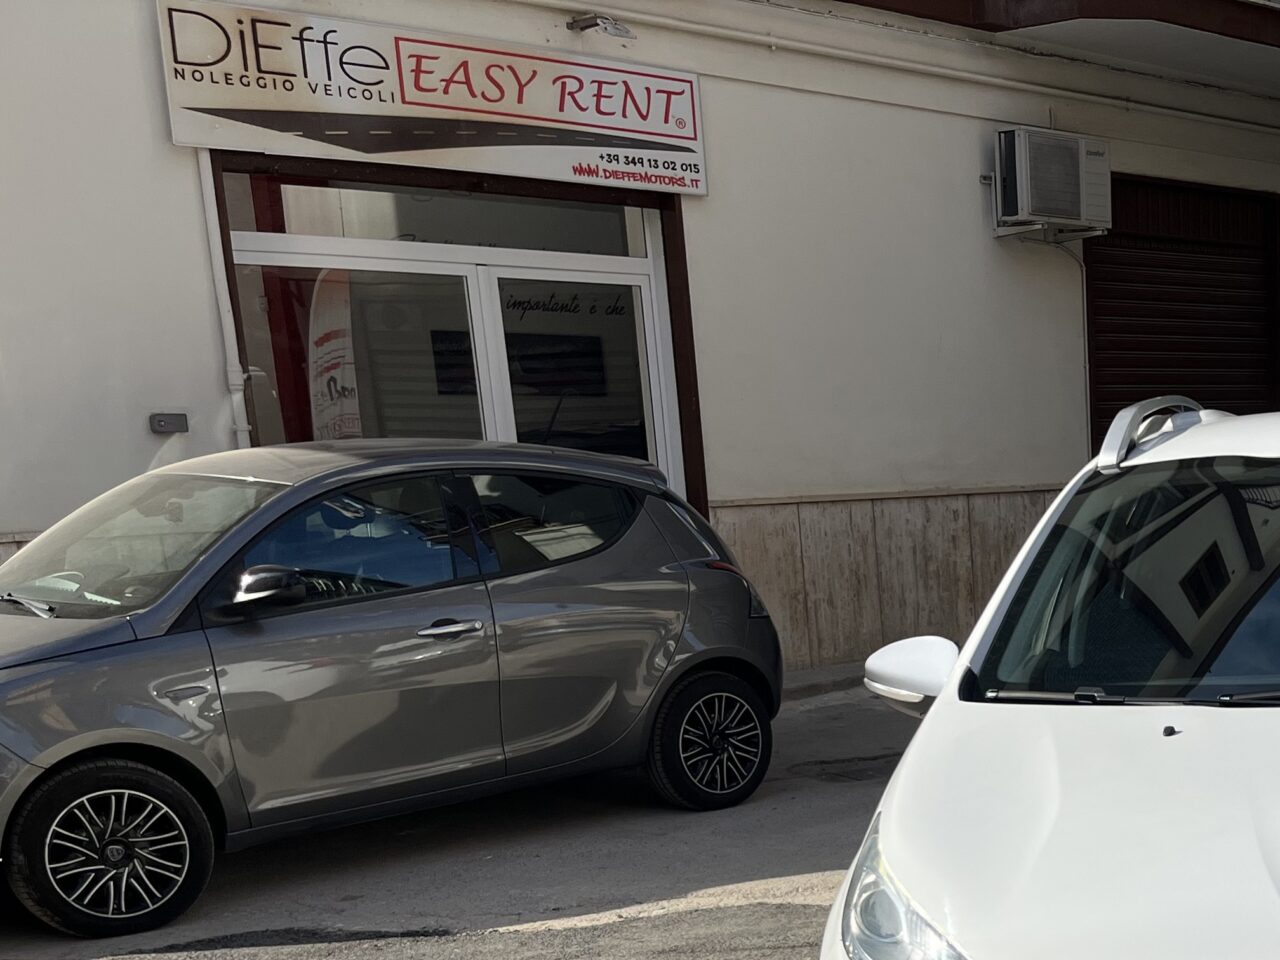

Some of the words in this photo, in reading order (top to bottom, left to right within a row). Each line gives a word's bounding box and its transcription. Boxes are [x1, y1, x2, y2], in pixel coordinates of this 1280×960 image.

[168, 8, 390, 86] DiEffe
[174, 67, 295, 92] NOLEGGIO
[308, 82, 395, 103] VEICOLI
[407, 54, 538, 104] EASY
[552, 75, 686, 124] RENT
[572, 162, 701, 188] WWW.DIEFFEMOTORS.IT
[599, 153, 620, 165] +39
[623, 155, 645, 167] 349
[647, 158, 659, 169] 13
[662, 161, 677, 171] 02
[680, 163, 700, 174] 015
[506, 292, 581, 321] importante
[605, 294, 626, 316] che
